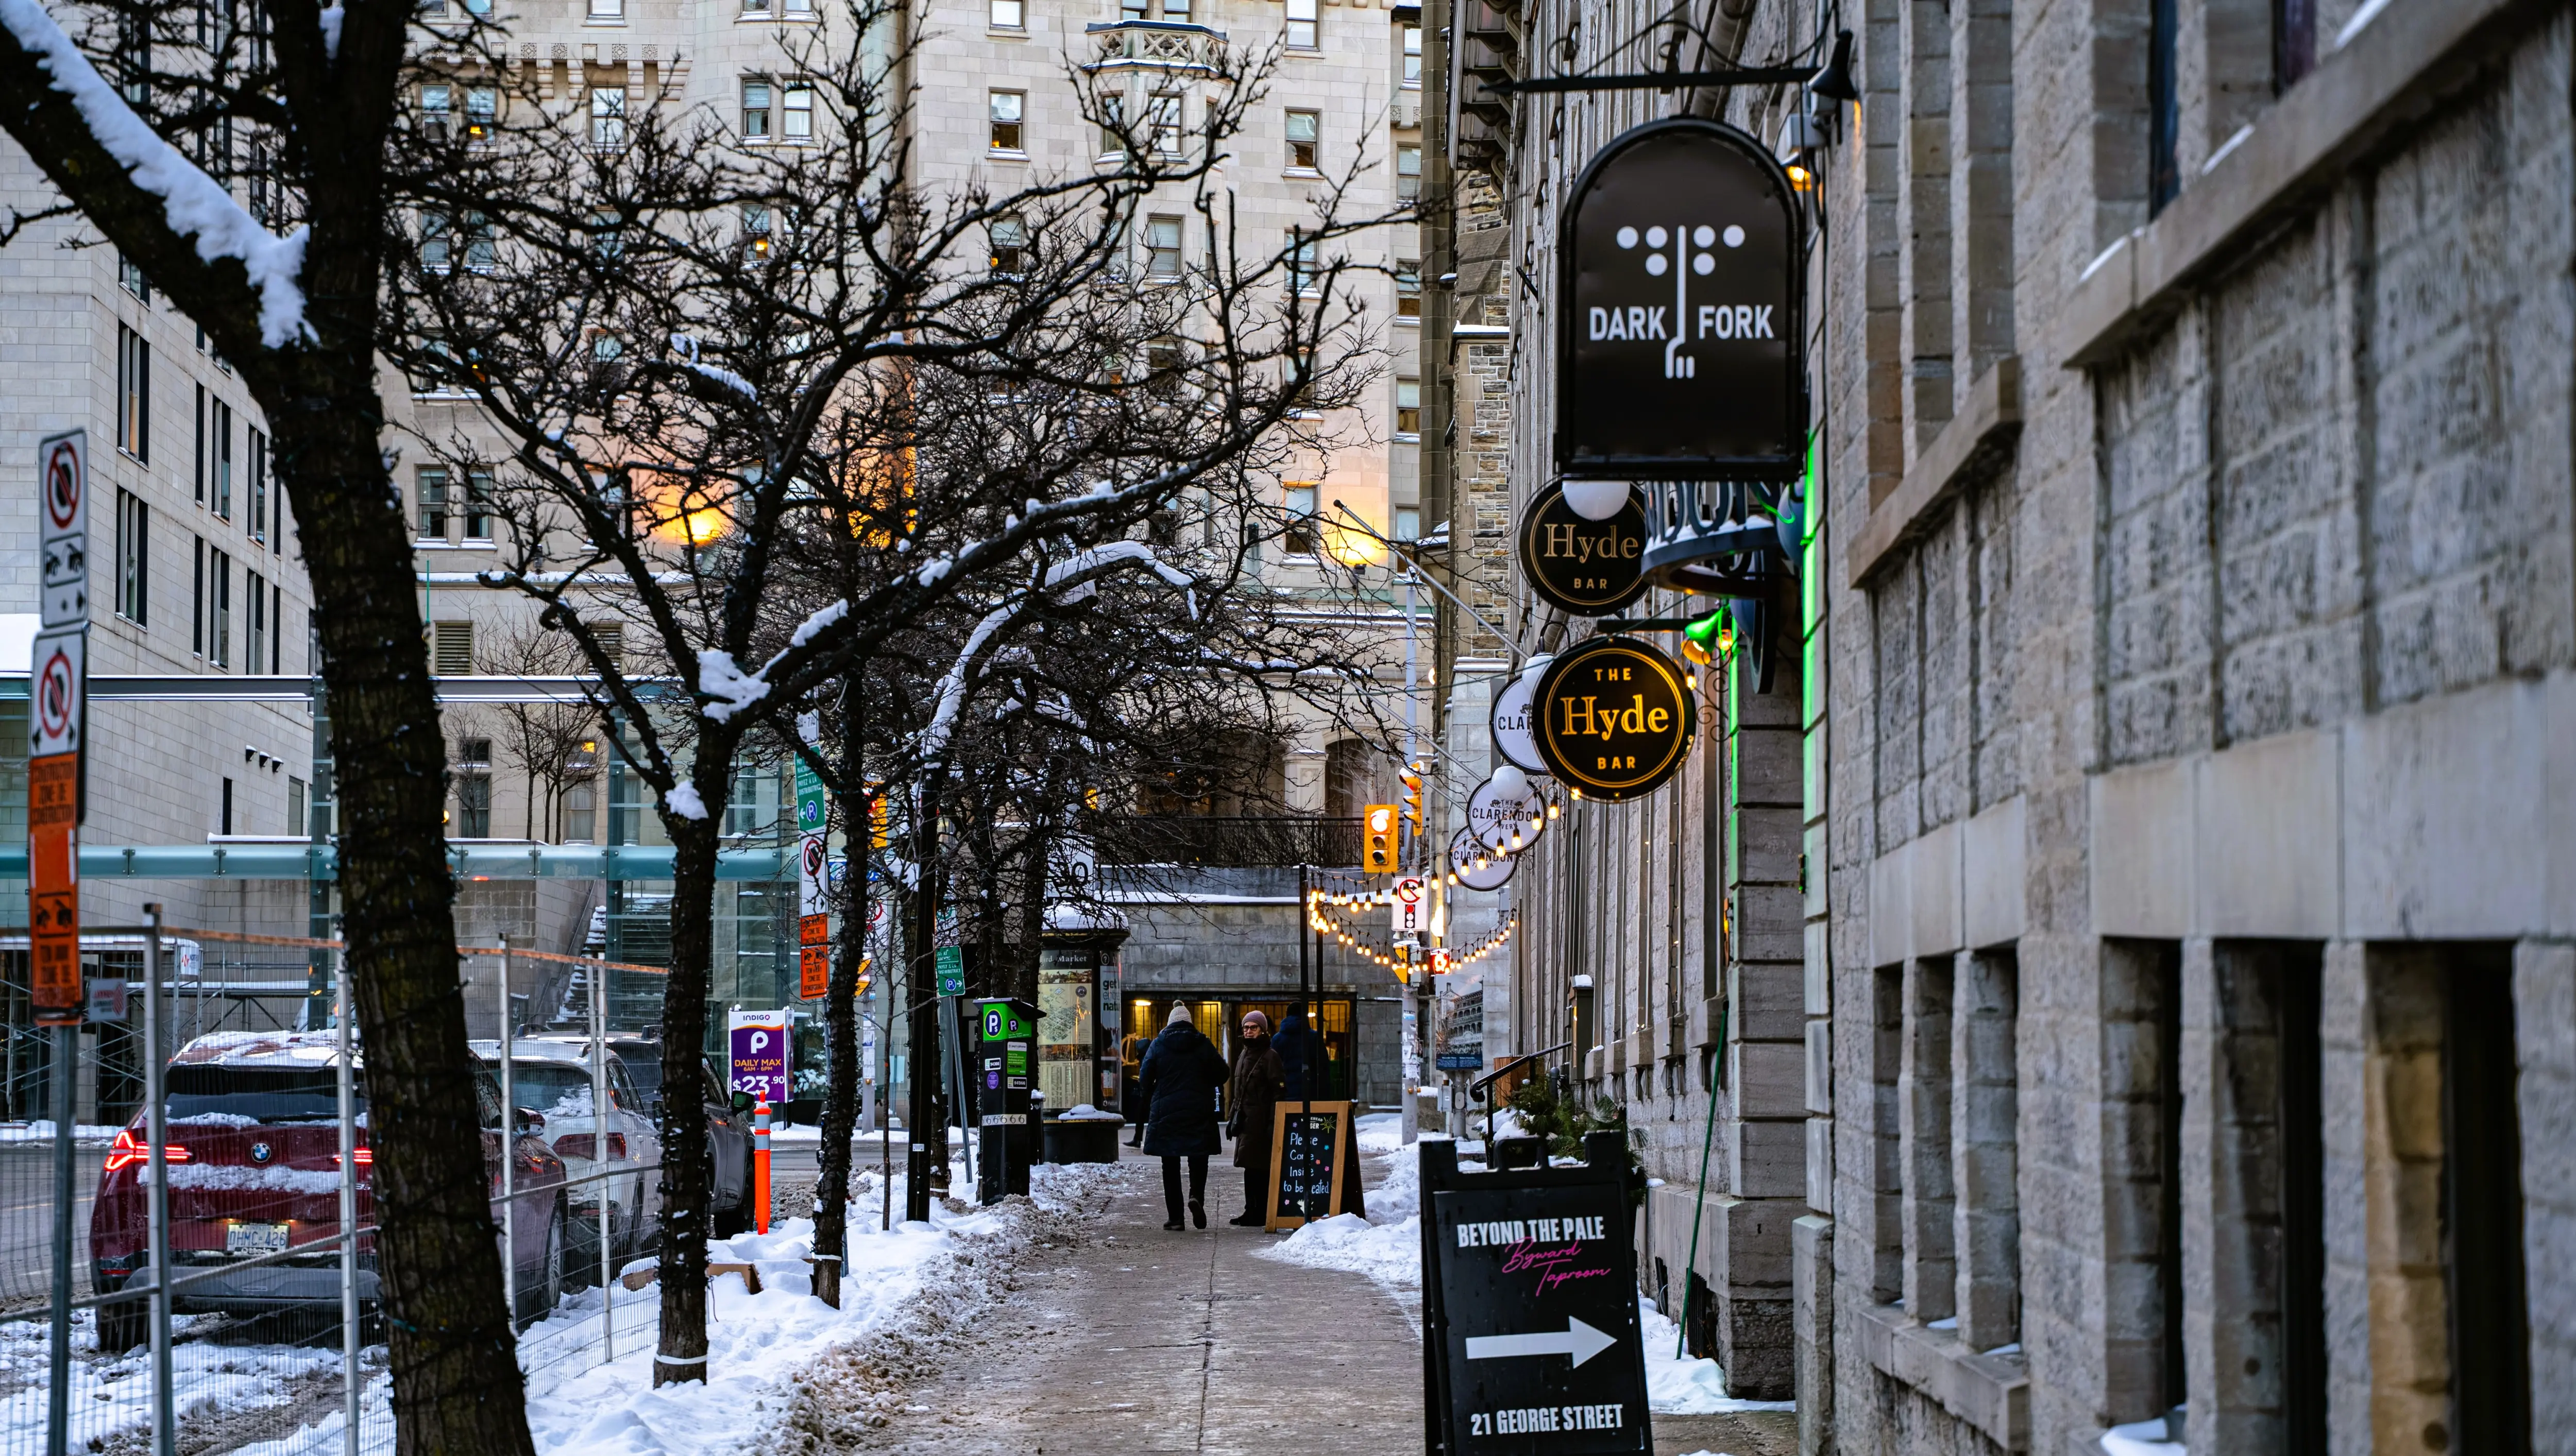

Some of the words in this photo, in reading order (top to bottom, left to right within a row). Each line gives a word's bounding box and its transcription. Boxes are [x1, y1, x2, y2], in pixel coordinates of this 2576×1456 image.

[1589, 306, 1667, 340] DARK
[1699, 304, 1774, 339] FORK
[1544, 524, 1638, 563] Hyde
[1574, 578, 1607, 589] BAR
[1594, 667, 1632, 681] THE
[1560, 694, 1669, 741] Hyde
[1597, 756, 1636, 769] BAR
[1472, 808, 1532, 822] CLARENDO
[751, 1031, 769, 1054] P
[1283, 1180, 1292, 1192] to
[1295, 1180, 1303, 1193] be
[1311, 1179, 1329, 1194] eated
[1456, 1221, 1525, 1247] BEYOND
[1527, 1219, 1561, 1242] THE
[1562, 1217, 1605, 1241] PALE
[1502, 1236, 1582, 1274] Byward
[1532, 1259, 1612, 1297] Taproom
[1470, 1413, 1492, 1435] 21
[1496, 1407, 1560, 1434] GEORGE
[1562, 1404, 1623, 1431] STREET
